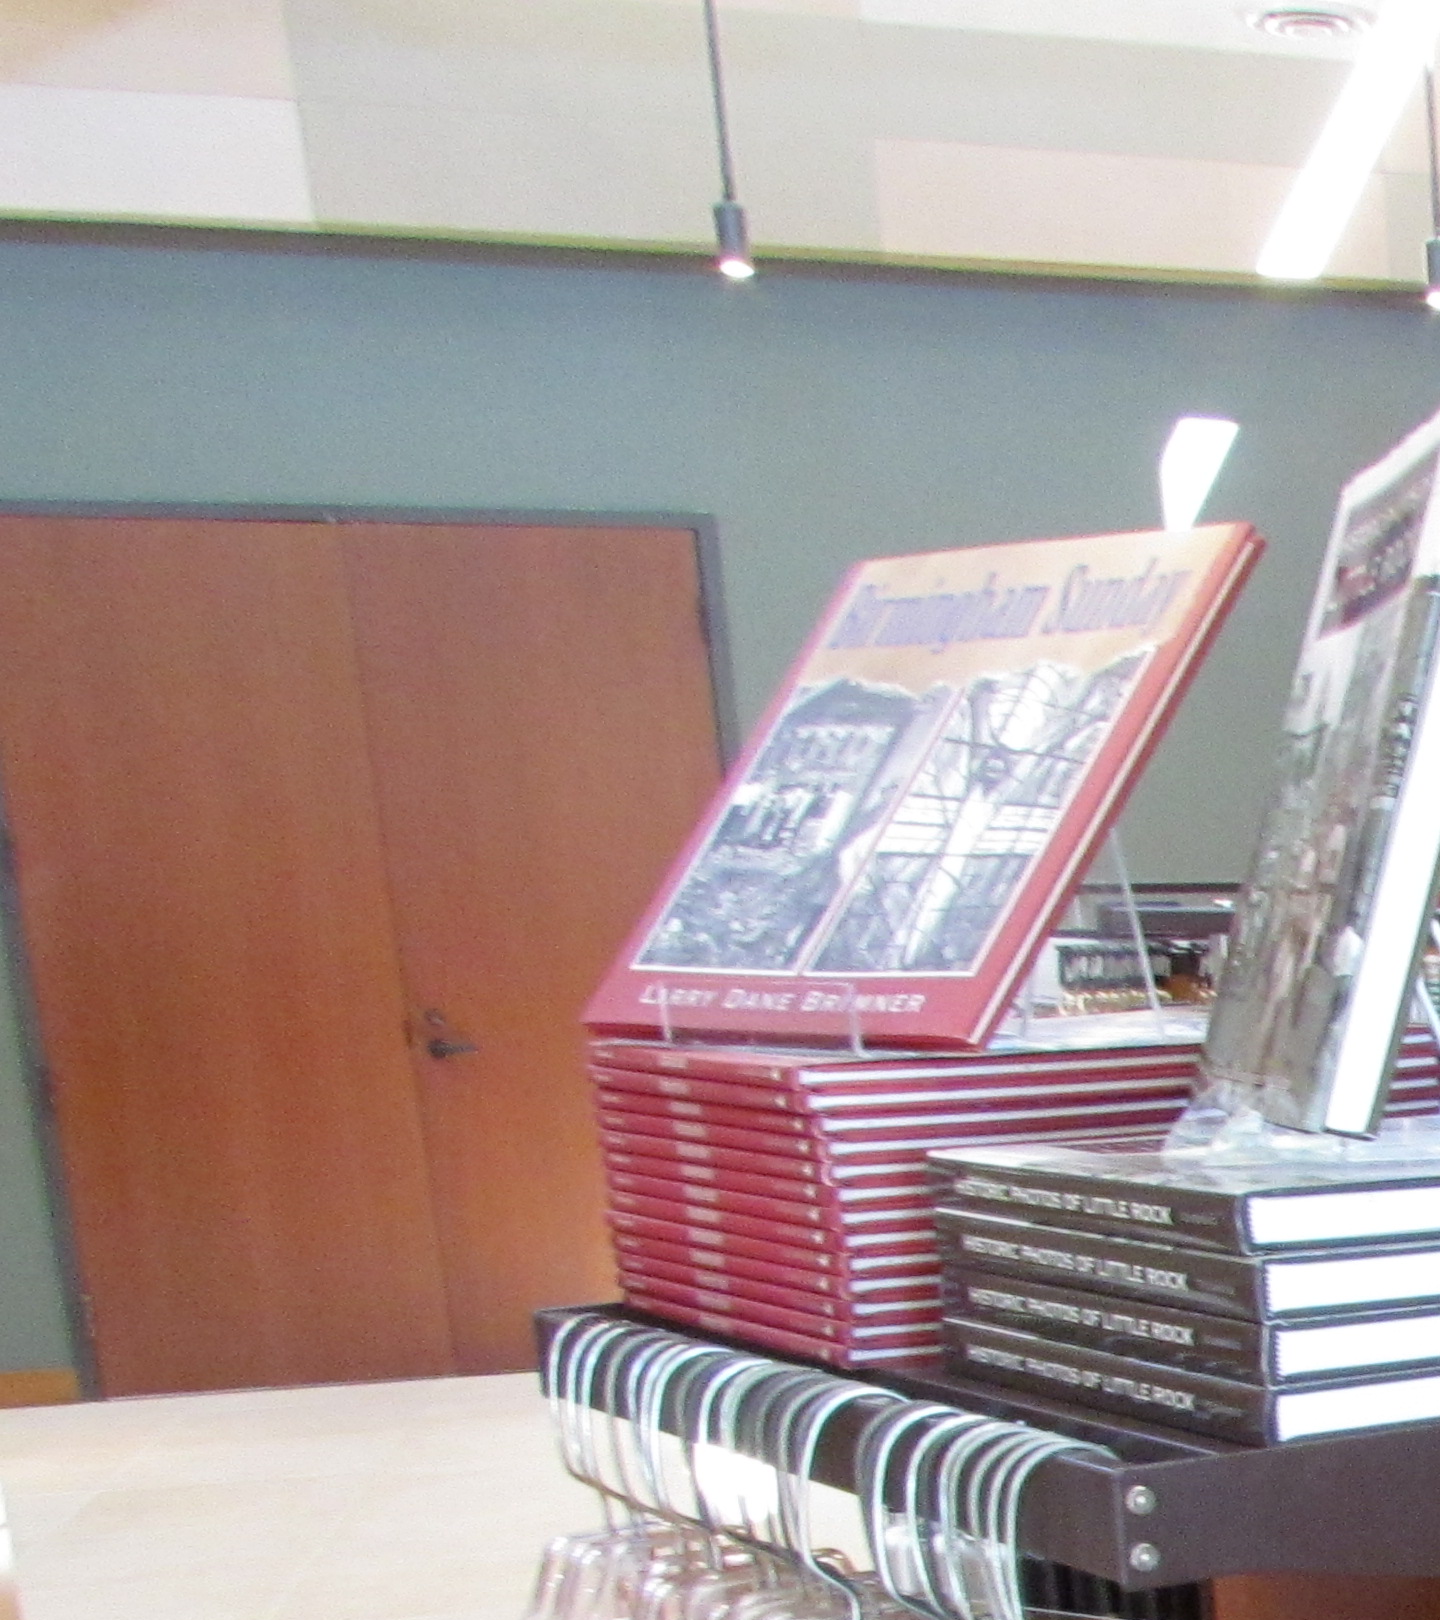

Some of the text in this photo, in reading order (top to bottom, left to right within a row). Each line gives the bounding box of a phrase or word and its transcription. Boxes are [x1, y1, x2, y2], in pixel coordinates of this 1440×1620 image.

[827, 558, 1192, 654] Birmingham Sunday
[723, 988, 792, 1011] DANE
[1063, 1194, 1081, 1211] OF
[1083, 1198, 1129, 1218] LITTLE
[1131, 1202, 1173, 1224] ROCK
[1076, 1254, 1094, 1273] OF
[1096, 1259, 1144, 1283] LITTLE
[1144, 1267, 1187, 1291] ROCK
[1082, 1308, 1100, 1326] OF
[1102, 1313, 1150, 1336] LITTLE
[1151, 1322, 1194, 1346] ROCK
[1083, 1370, 1100, 1387] OF
[1102, 1376, 1150, 1401] LITTLE
[1151, 1387, 1195, 1411] ROCK
